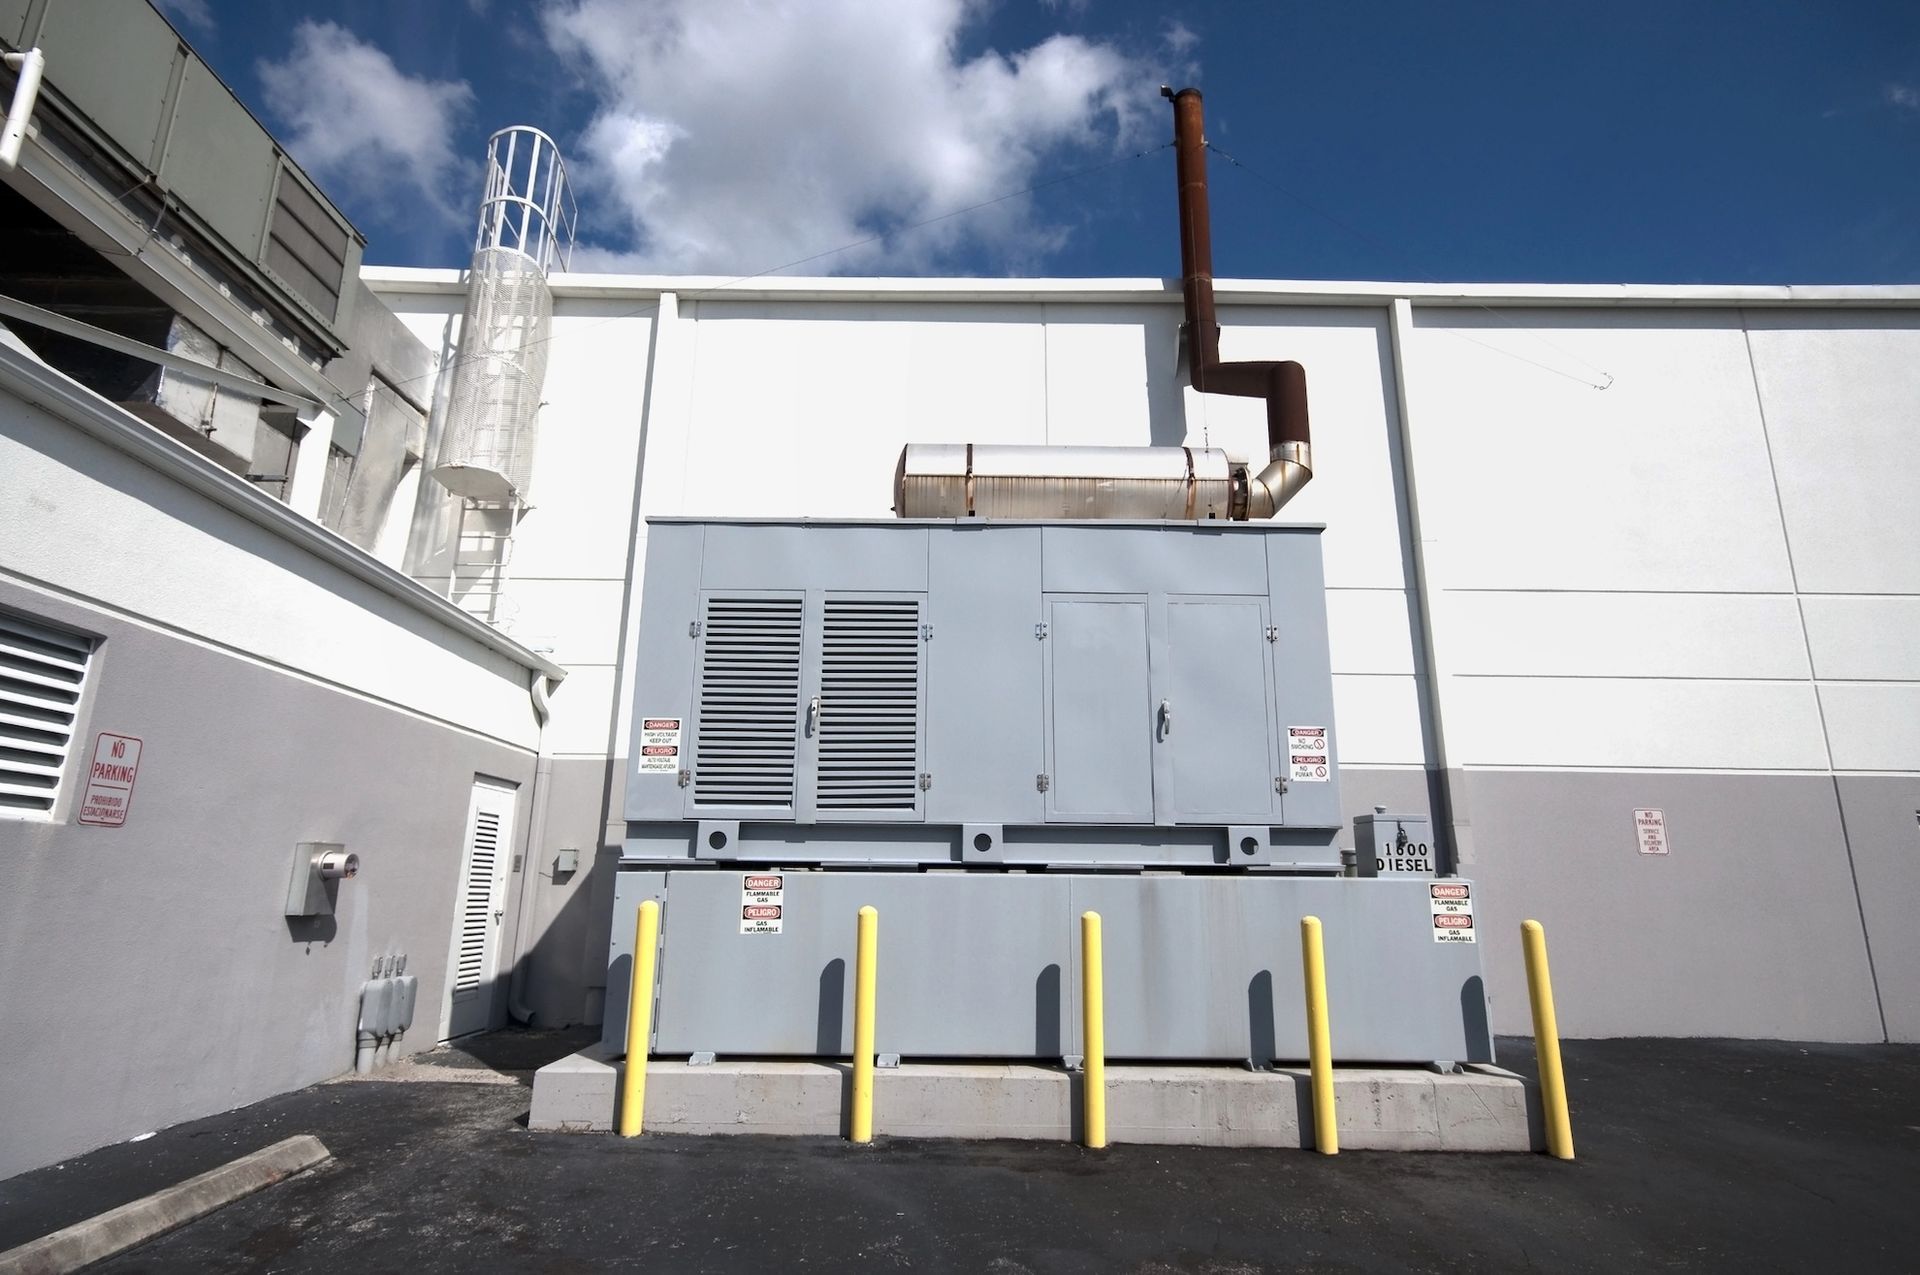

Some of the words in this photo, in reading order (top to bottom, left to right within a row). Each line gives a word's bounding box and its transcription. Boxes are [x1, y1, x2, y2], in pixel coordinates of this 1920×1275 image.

[111, 741, 125, 759] NO
[92, 762, 134, 783] PARKING
[90, 795, 122, 808] PROHIBIDO
[83, 806, 124, 819] ESTACIONARSE
[1638, 818, 1662, 826] PARKING
[1385, 843, 1428, 856] 1600
[1376, 858, 1433, 871] DIESEL
[748, 879, 779, 887] DANGER
[1434, 887, 1466, 896] DANGER
[748, 908, 777, 917] PELIGRO
[1438, 917, 1468, 926] PELIGRO
